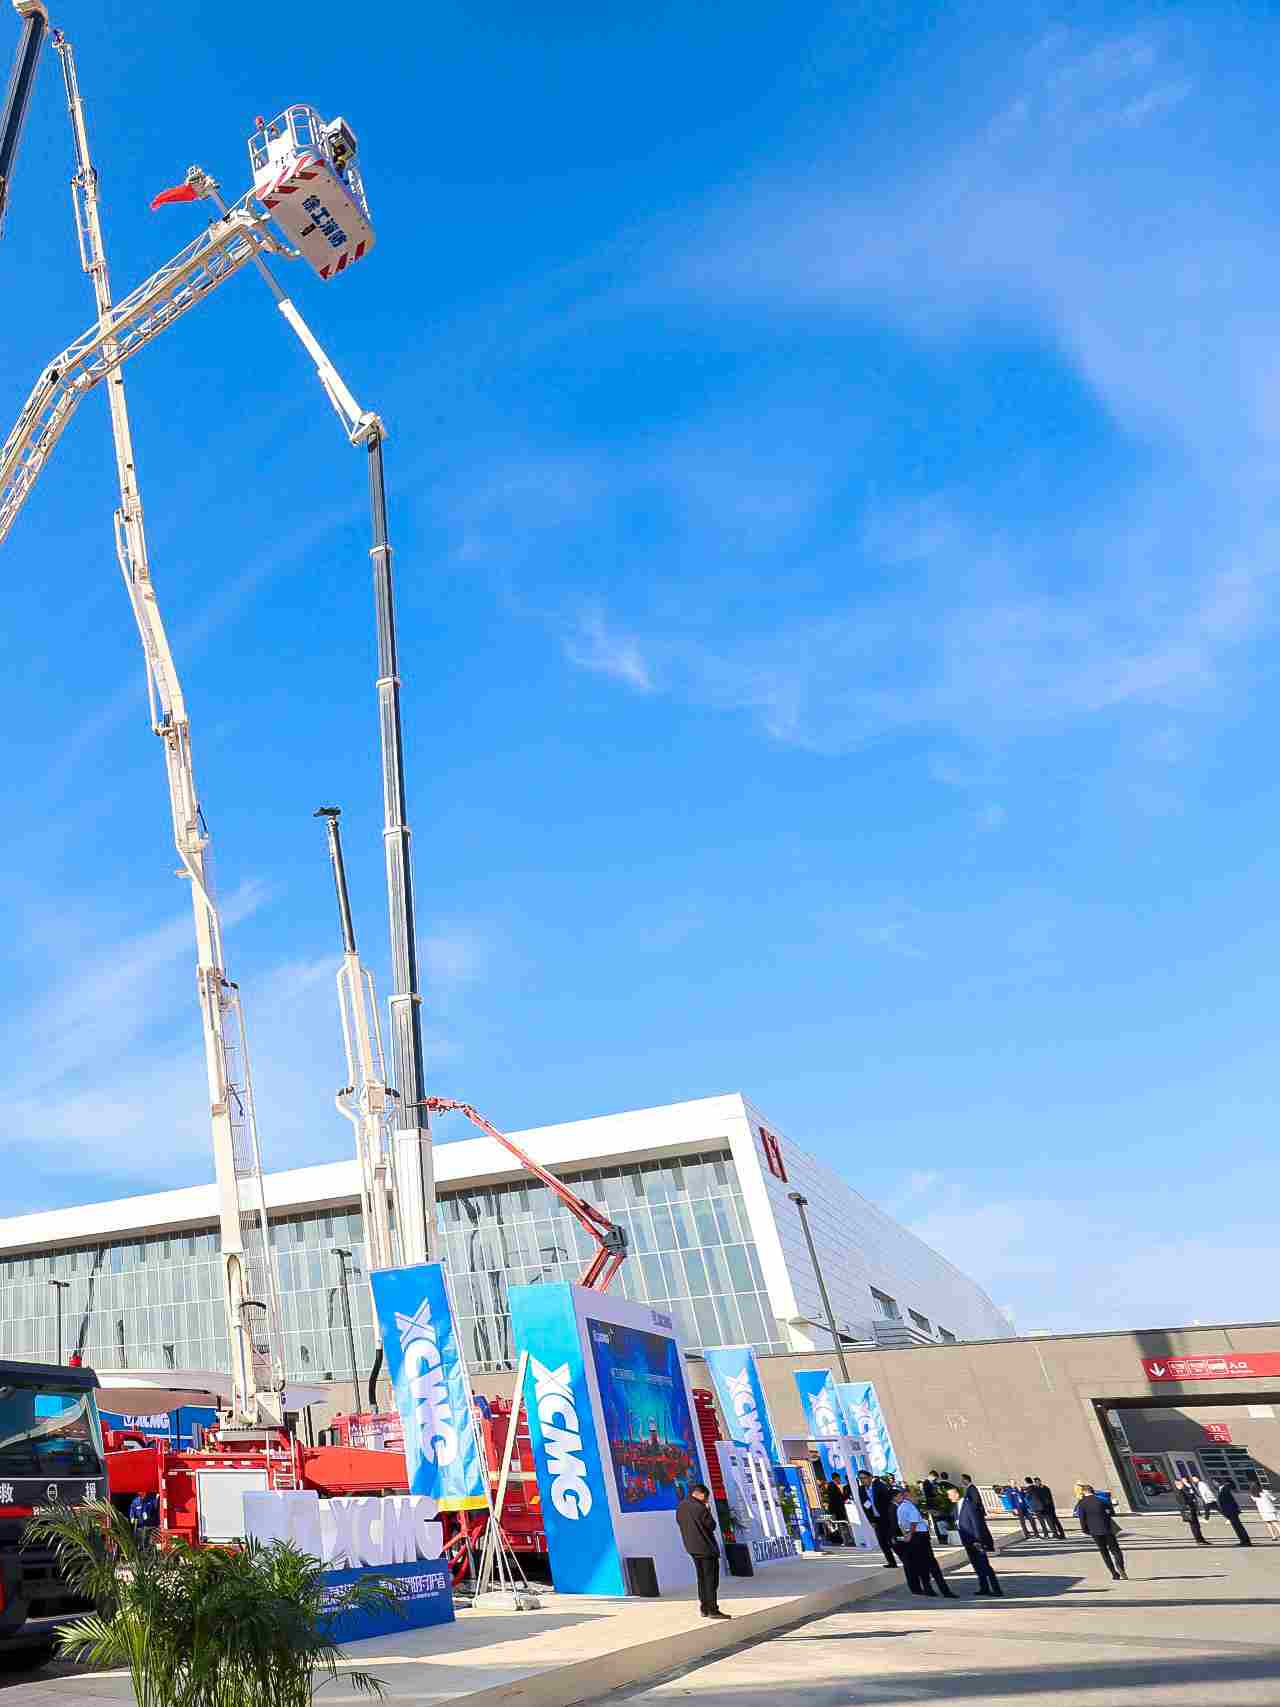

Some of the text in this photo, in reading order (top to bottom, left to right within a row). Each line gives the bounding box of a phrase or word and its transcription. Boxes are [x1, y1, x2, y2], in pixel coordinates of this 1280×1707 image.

[393, 1296, 459, 1467] XCMG
[529, 1354, 593, 1521] XCMG
[320, 1496, 444, 1572] XCMG
